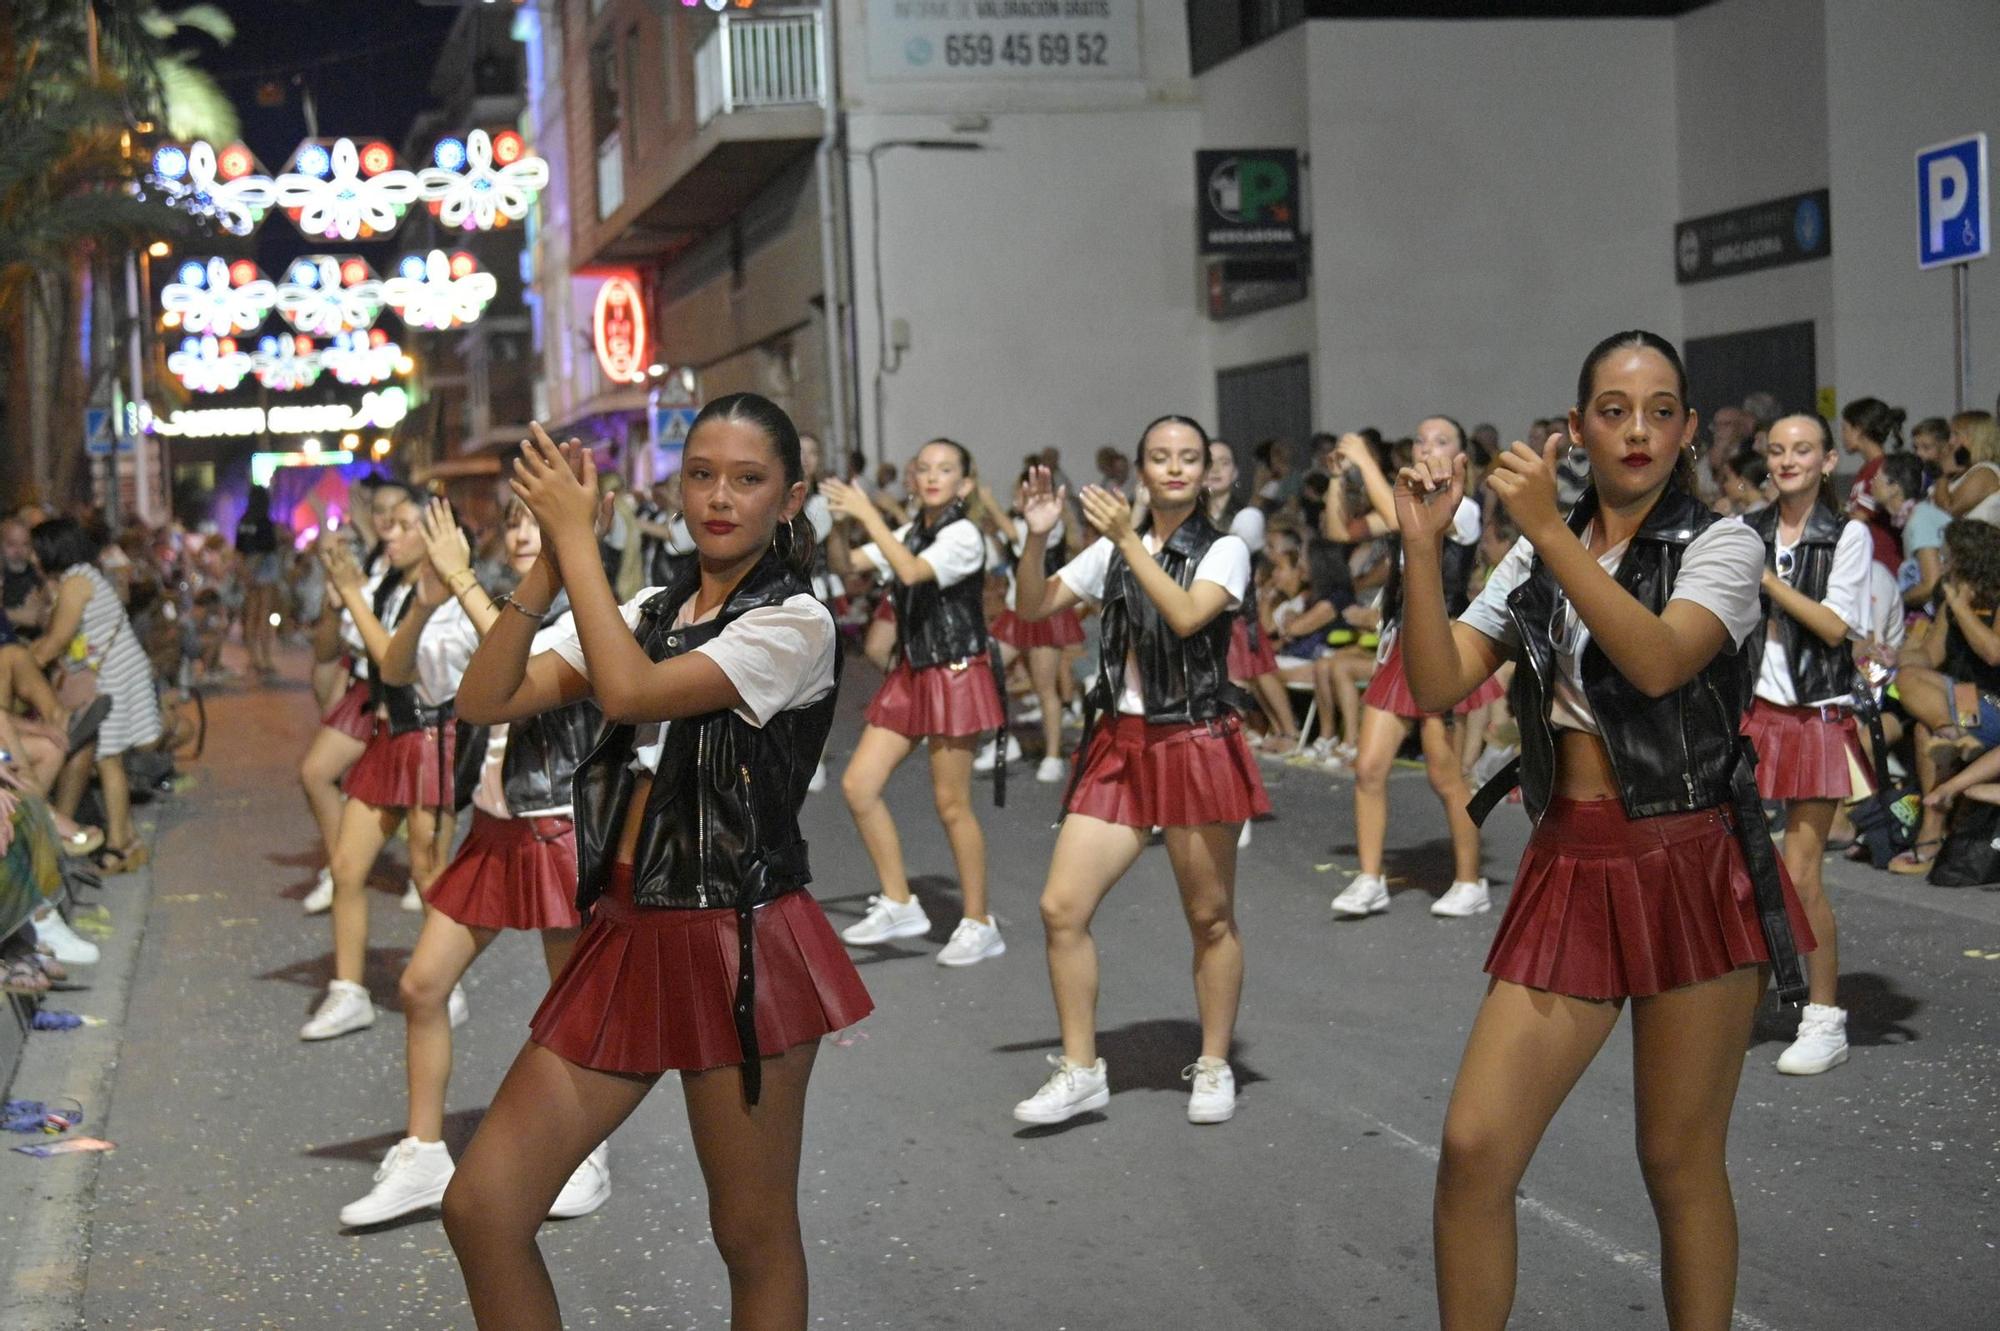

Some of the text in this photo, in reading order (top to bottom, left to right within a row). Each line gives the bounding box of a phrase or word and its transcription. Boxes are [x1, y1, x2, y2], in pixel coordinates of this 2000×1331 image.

[945, 33, 1107, 66] 659 45 69 52
[1928, 156, 1968, 253] P
